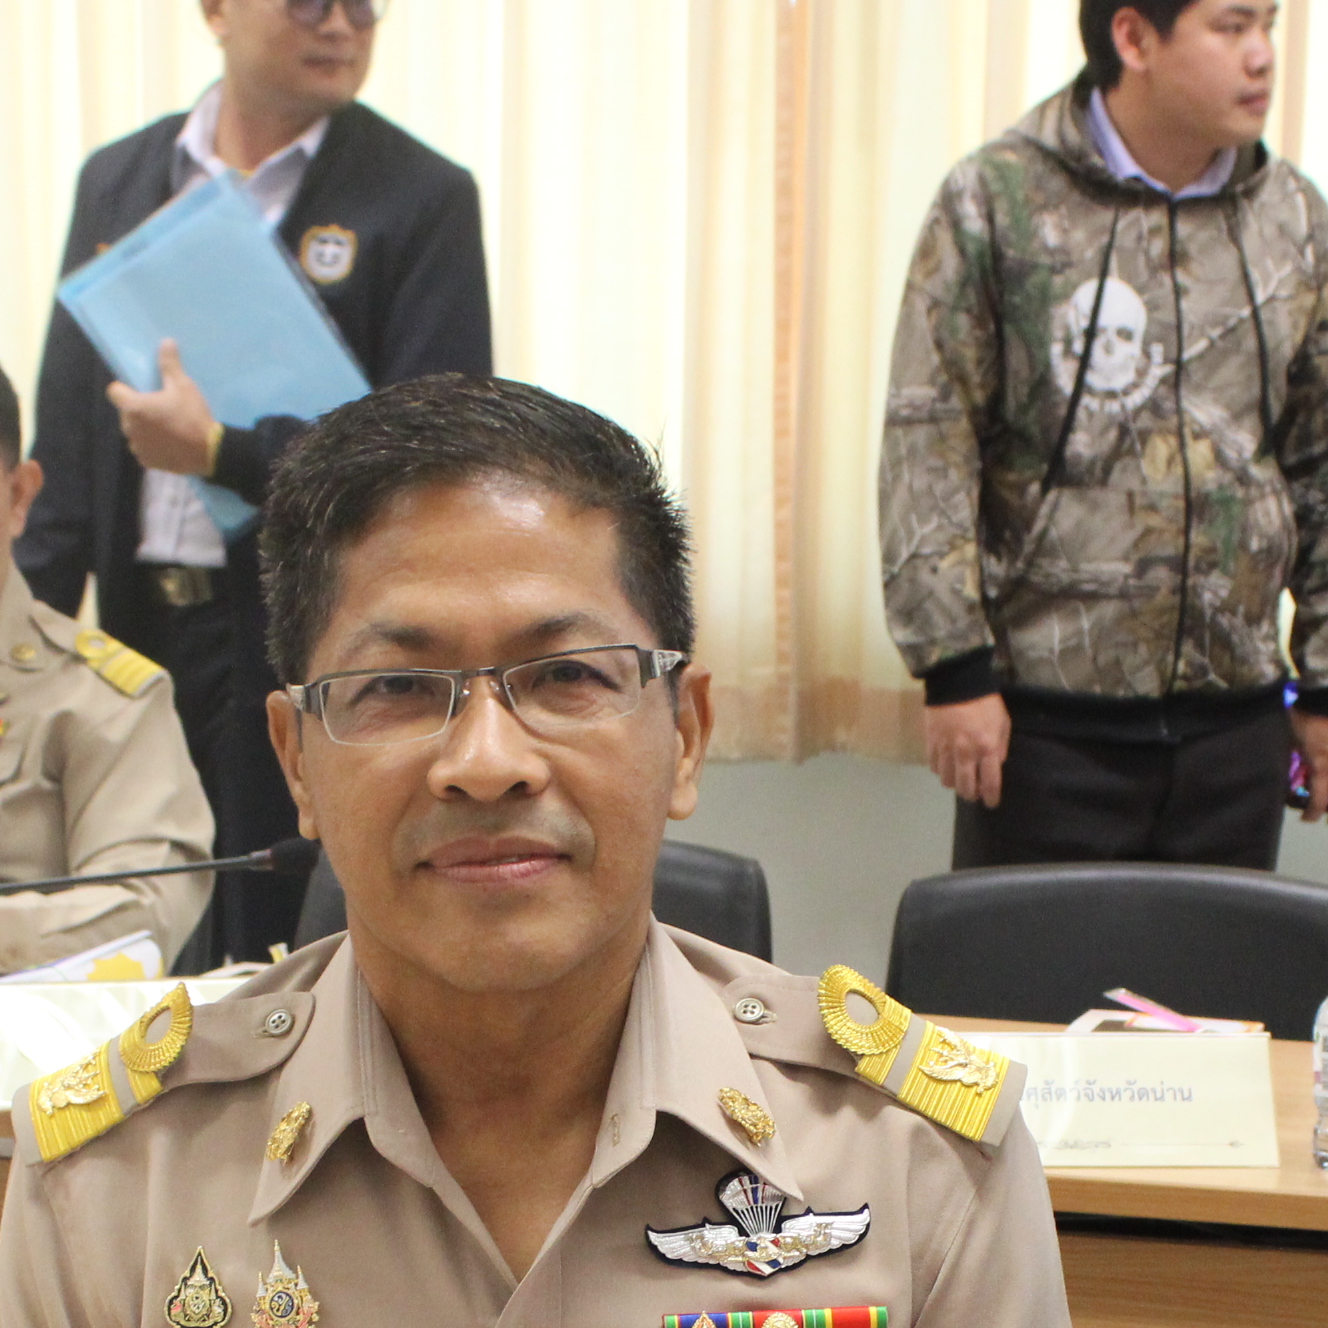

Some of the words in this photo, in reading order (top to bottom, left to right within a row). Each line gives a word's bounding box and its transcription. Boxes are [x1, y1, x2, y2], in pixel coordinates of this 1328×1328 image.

[1020, 1080, 1194, 1109] ศุสัตว์จังหวัดน่าน
